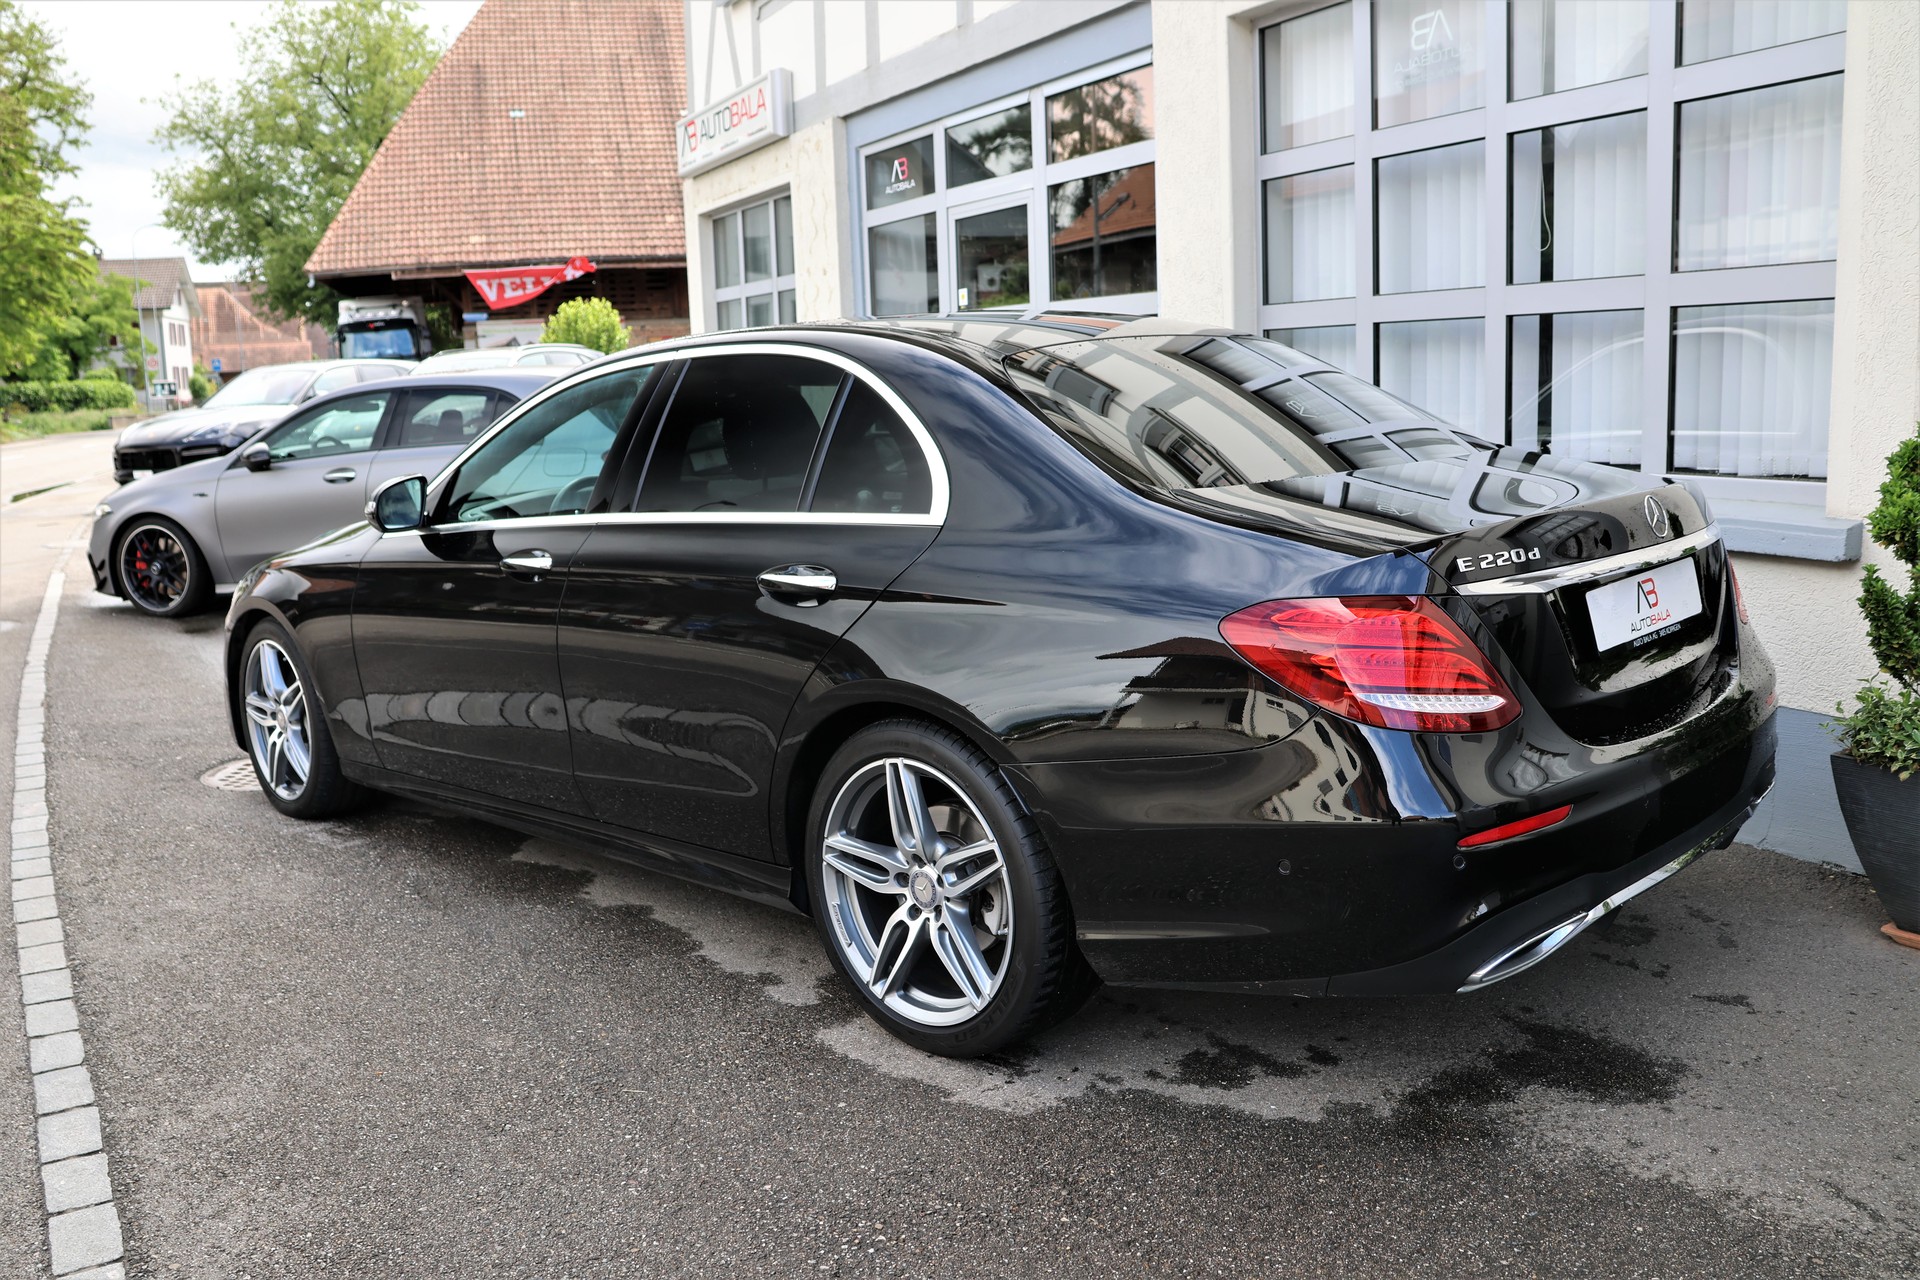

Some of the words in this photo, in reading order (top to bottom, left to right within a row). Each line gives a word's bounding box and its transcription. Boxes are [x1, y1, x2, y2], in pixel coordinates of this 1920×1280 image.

[700, 87, 767, 144] AUTOBALA
[1456, 556, 1476, 573] E
[1631, 609, 1671, 634] AUTOBALA
